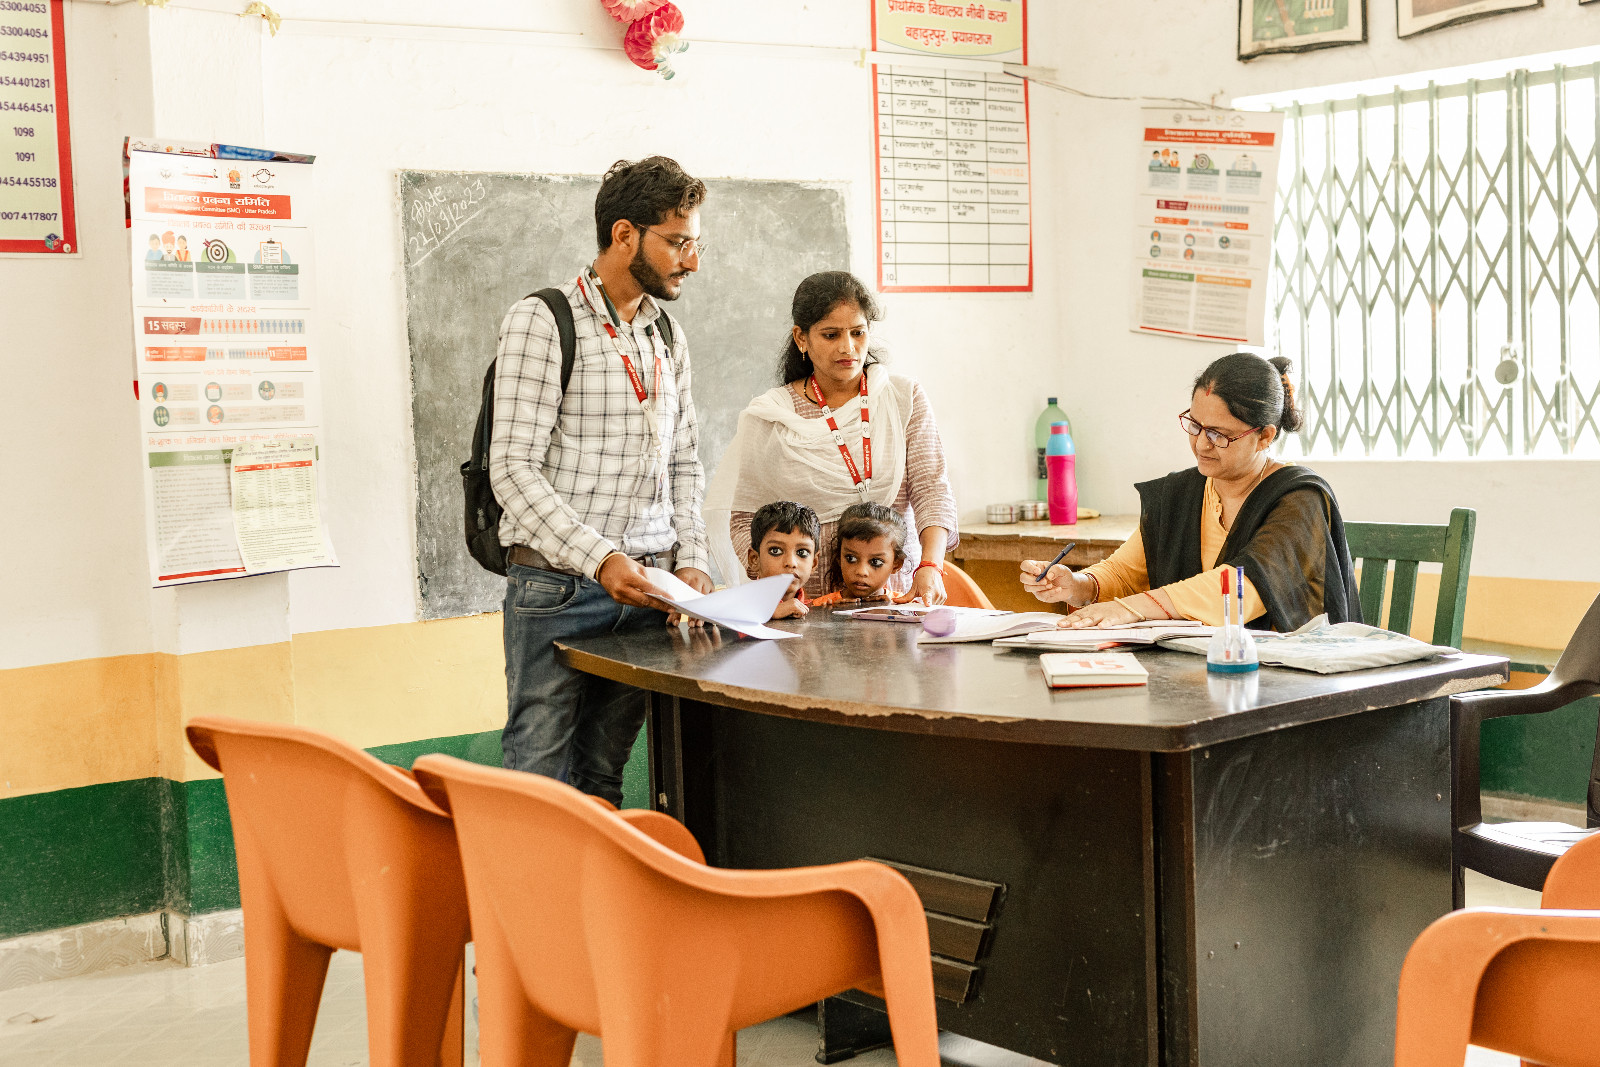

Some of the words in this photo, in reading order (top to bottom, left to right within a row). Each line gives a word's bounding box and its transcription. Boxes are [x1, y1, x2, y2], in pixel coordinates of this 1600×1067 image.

[928, 0, 963, 18] विद्यालय
[987, 10, 1008, 23] कला
[951, 31, 992, 46] प्रयागराज
[13, 127, 35, 138] 1098
[15, 151, 35, 162] 1091
[234, 197, 271, 207] समिति
[0, 211, 58, 222] 007417807
[148, 320, 160, 331] 15
